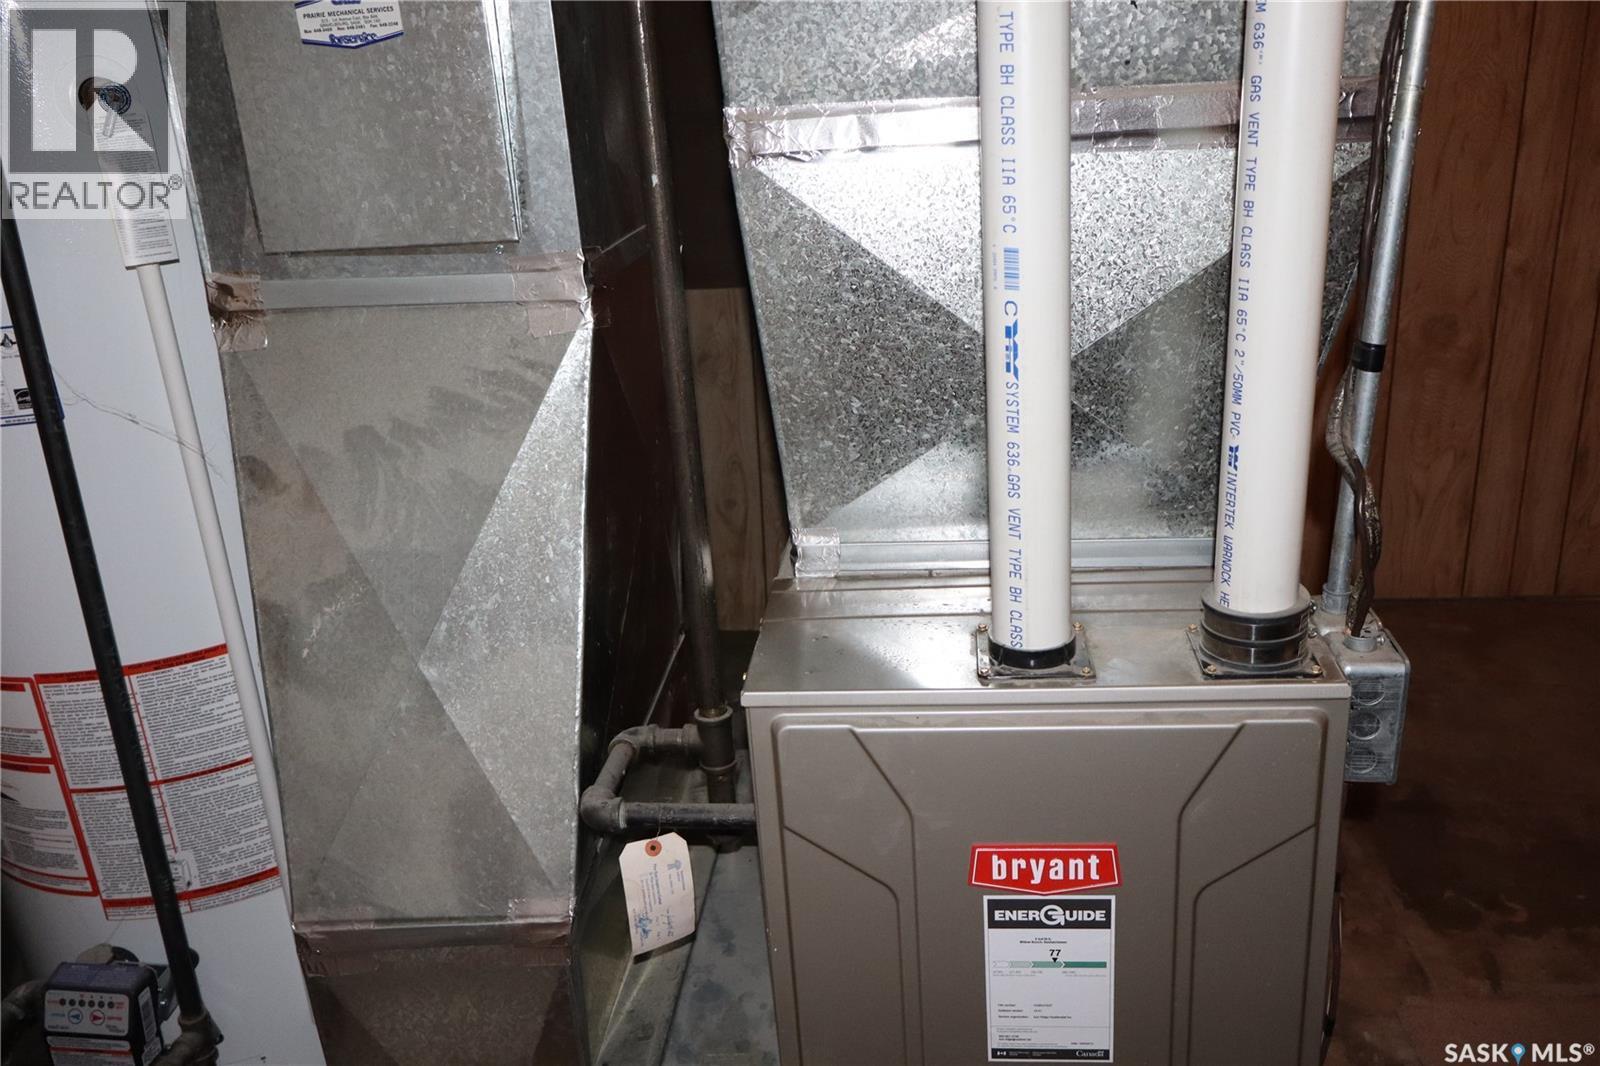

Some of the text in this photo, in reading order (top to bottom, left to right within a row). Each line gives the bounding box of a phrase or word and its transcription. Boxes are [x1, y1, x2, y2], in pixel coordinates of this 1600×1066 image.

[327, 7, 365, 17] MECHANICAL
[366, 5, 394, 14] SERVICES
[999, 11, 1014, 53] TYPE
[1000, 64, 1014, 85] BH
[1249, 75, 1262, 102] GAS
[1000, 95, 1016, 145] CLASS
[1247, 112, 1260, 147] VENT
[1001, 158, 1016, 186] IIA
[1244, 157, 1257, 191] TYPE
[1242, 200, 1255, 218] BH
[1239, 226, 1253, 268] CLASS
[1005, 381, 1020, 434] SYSTEM
[1007, 474, 1021, 499] GAS
[1223, 471, 1238, 529] INTERTEK
[1008, 508, 1022, 540] VENT
[1009, 549, 1023, 579] TYPE
[1220, 535, 1233, 586] WARNOCK
[1010, 586, 1023, 603] BH
[1010, 609, 1024, 648] CLASS
[991, 854, 1100, 884] bryant
[994, 904, 1106, 926] ENERGUIDE
[1049, 949, 1061, 957] 77
